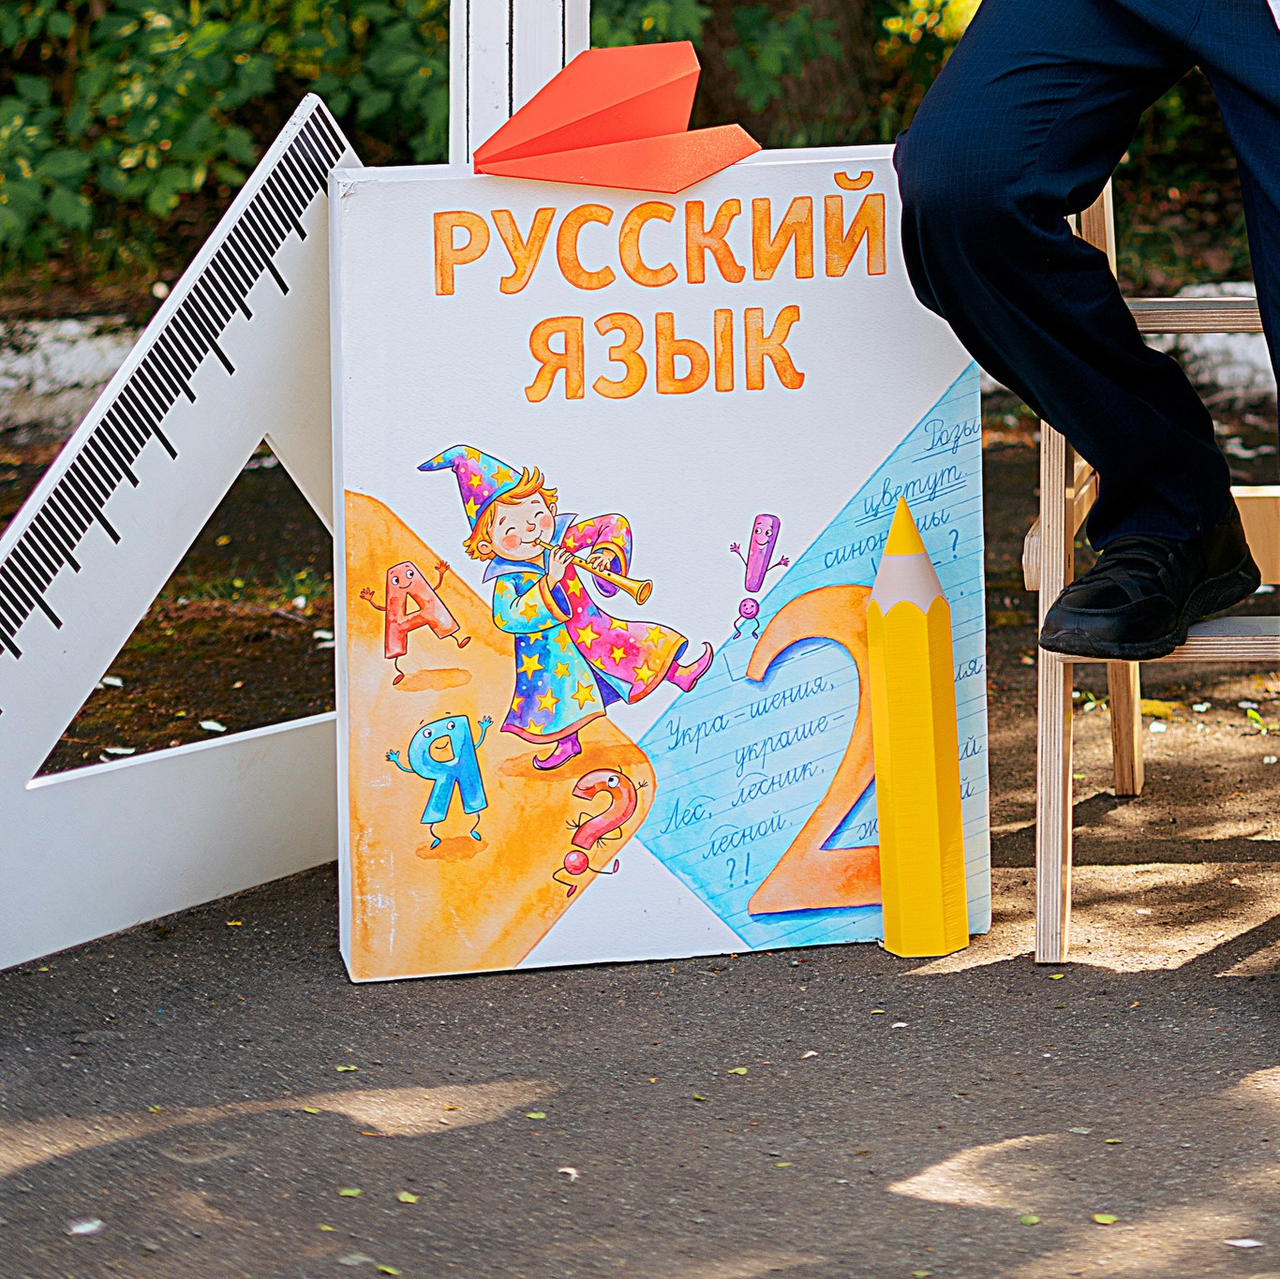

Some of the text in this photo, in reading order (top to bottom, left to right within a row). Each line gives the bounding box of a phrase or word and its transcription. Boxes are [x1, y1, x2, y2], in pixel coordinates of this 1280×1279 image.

[433, 171, 887, 295] РУССКИЙ
[525, 305, 805, 403] ЯЗЫК
[924, 418, 980, 454] Розы
